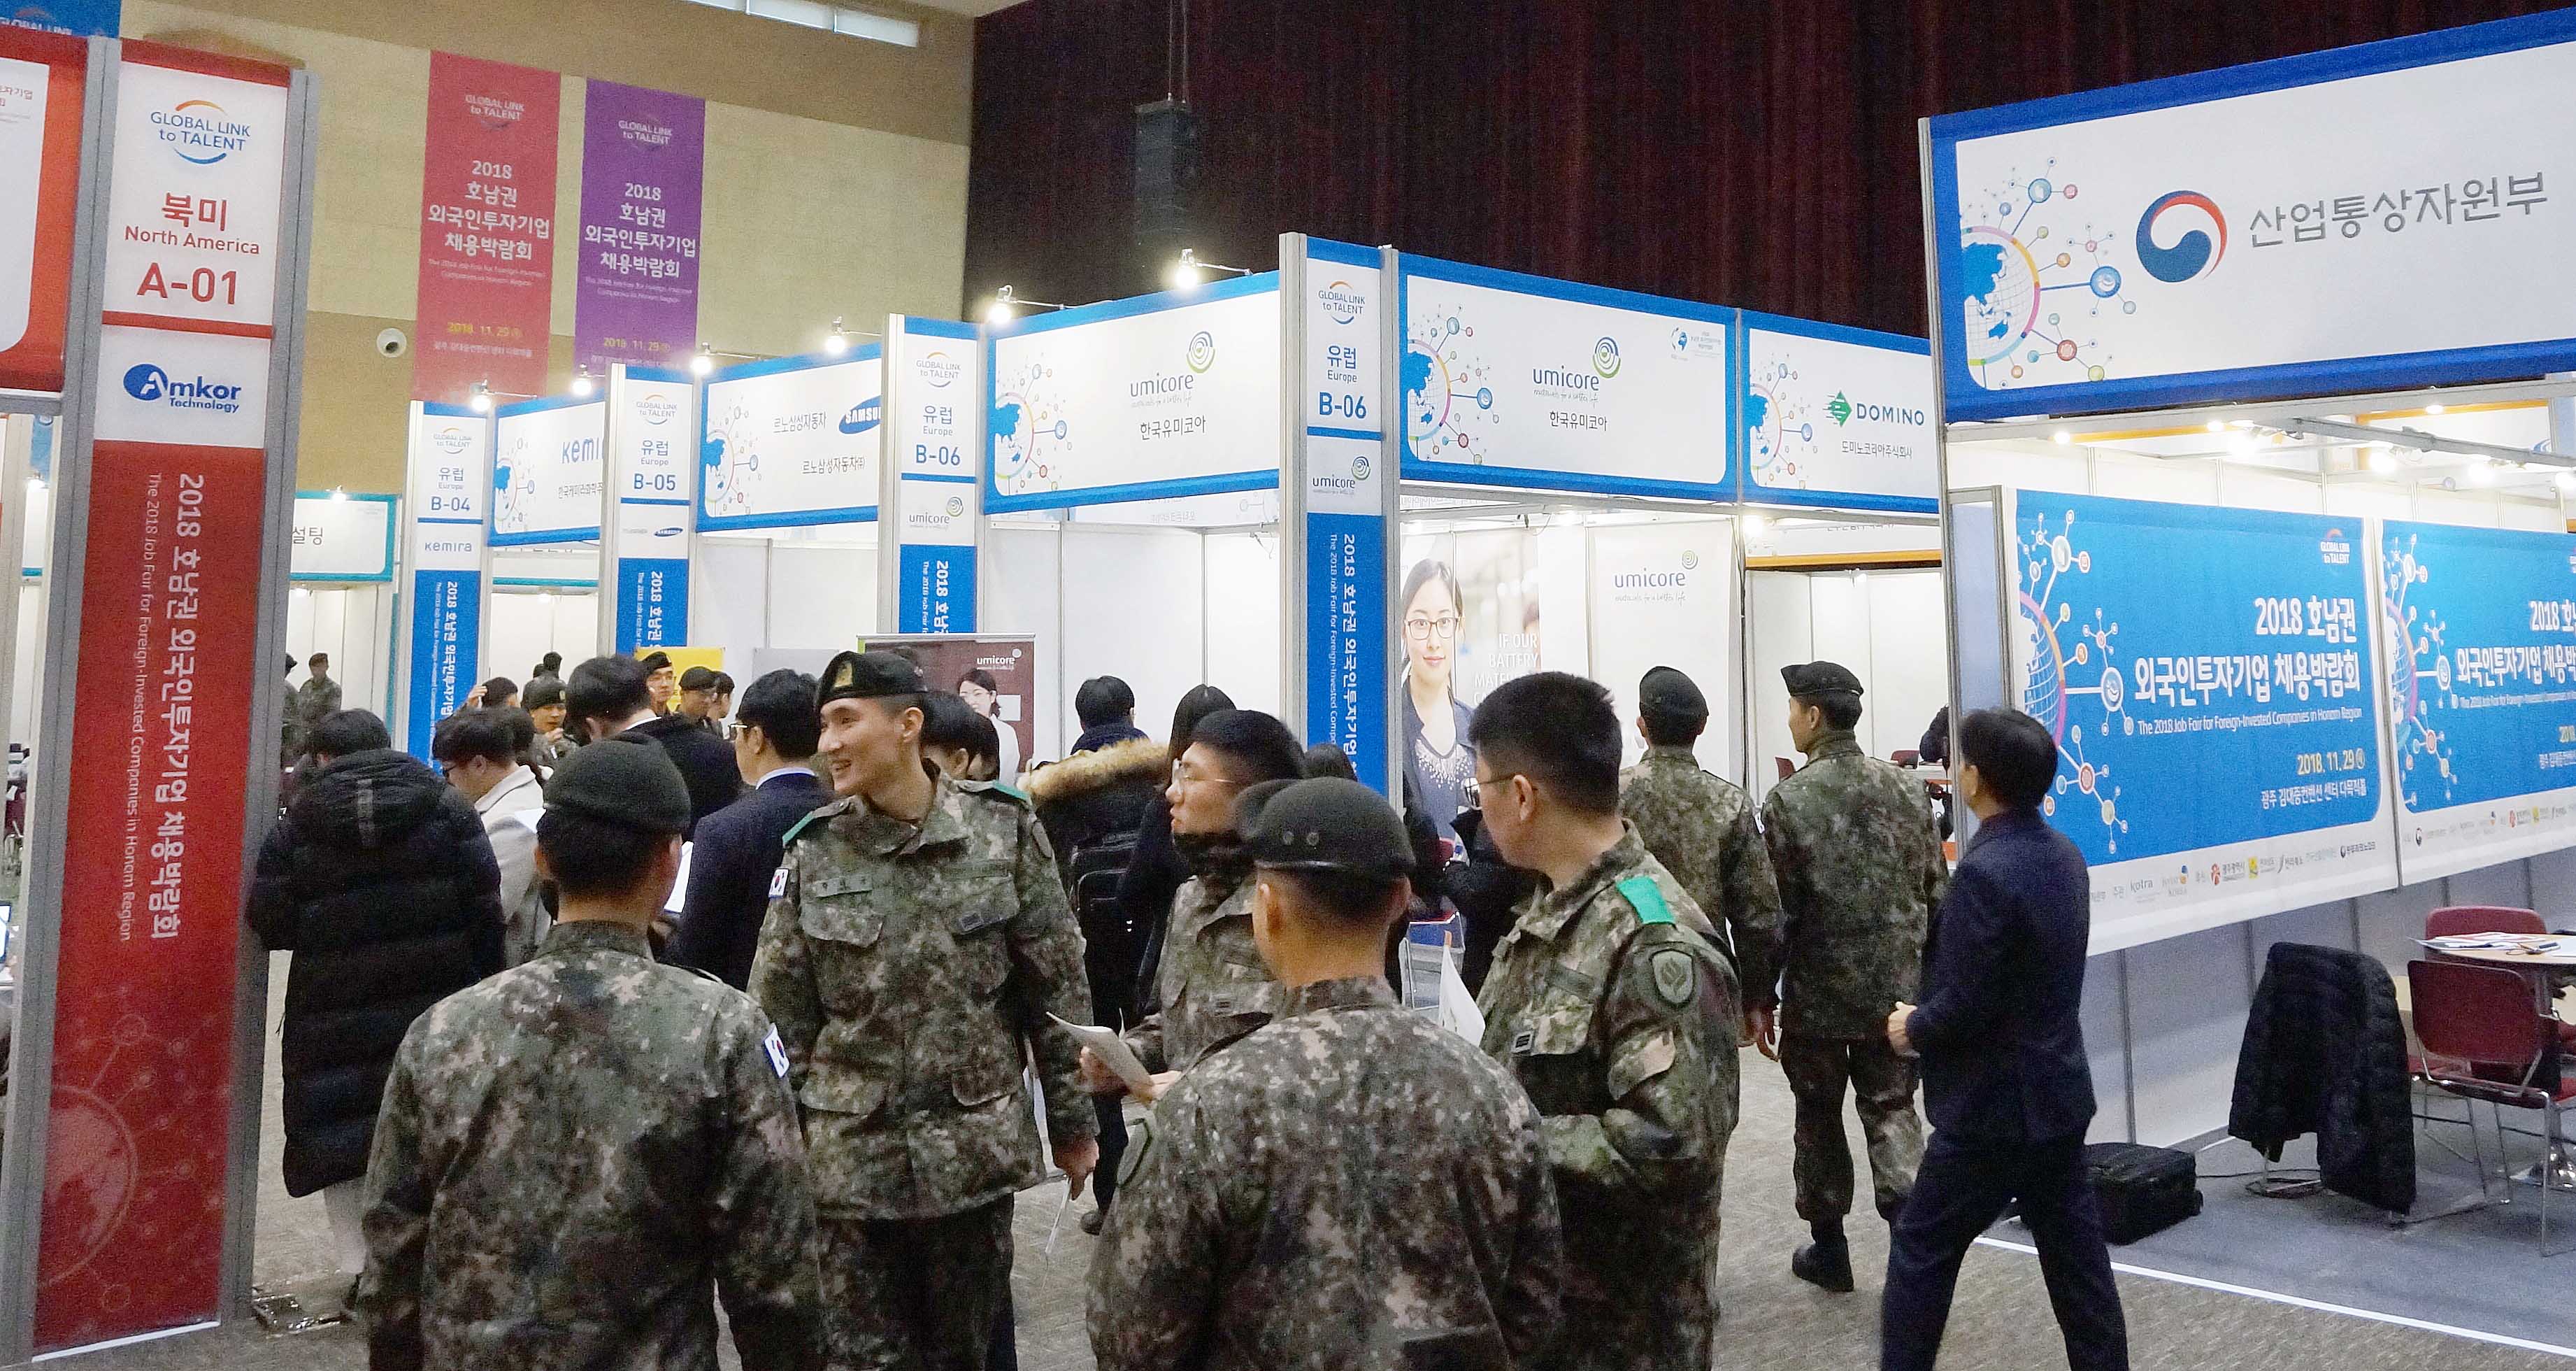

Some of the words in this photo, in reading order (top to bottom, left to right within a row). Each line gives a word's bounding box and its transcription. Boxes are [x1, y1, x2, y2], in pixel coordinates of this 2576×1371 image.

[465, 94, 502, 111] GLOBAL
[503, 99, 524, 113] LINK
[471, 106, 481, 115] to
[483, 108, 522, 122] TALENT
[150, 111, 213, 133] GLOBAL
[218, 121, 250, 138] LINK
[618, 120, 652, 135] GLOBAL
[653, 125, 672, 136] LINK
[159, 129, 176, 142] to
[181, 131, 246, 152] TALENT
[634, 132, 671, 145] TALENT
[472, 160, 512, 180] 2018
[464, 180, 517, 208] 호남권
[624, 183, 661, 201] 2018
[162, 192, 227, 231] 북미
[427, 204, 550, 240] 외국인투자기업
[620, 203, 666, 229] 호남권
[2249, 171, 2548, 248] 산업통상자원부
[125, 226, 178, 247] North
[183, 233, 259, 255] America
[444, 232, 532, 260] 채용박람회
[585, 225, 696, 257] 외국인투자기업
[600, 252, 680, 278] 채용박람회
[137, 262, 237, 305] A-01
[1318, 290, 1347, 303] GLOBAL
[1349, 294, 1366, 306] LINK
[1323, 302, 1331, 311] to
[1333, 302, 1364, 315] TALENT
[916, 360, 944, 369] GLOBAL
[945, 363, 961, 371] LINK
[1327, 346, 1357, 370] 유럽
[124, 363, 242, 402] Amkor
[930, 369, 959, 379] TALENT
[1130, 372, 1194, 397] umicore
[1327, 370, 1357, 384] Europe
[1533, 364, 1599, 391] umicore
[170, 397, 239, 413] Technology
[845, 406, 881, 425] SAMSU
[923, 405, 952, 425] 유럽
[1319, 392, 1367, 420] B-06
[1857, 403, 1924, 425] DOMINO
[773, 411, 827, 433] 르노삼성자동차
[923, 426, 953, 436] Europe
[1140, 415, 1206, 440] 한국유미코아
[1550, 411, 1608, 432] 한국유미코아
[561, 436, 604, 464] kemi
[641, 439, 668, 456] 유럽
[916, 444, 961, 466] B-06
[1841, 441, 1912, 459] 도미노코리아주식회사
[438, 467, 464, 481] 유럽
[641, 457, 668, 467] Europe
[148, 472, 162, 497] The
[634, 473, 676, 491] B-05
[1312, 474, 1356, 489] umicore
[176, 474, 204, 537] 2018
[431, 496, 471, 512] B-04
[145, 501, 160, 534] 2018
[909, 512, 950, 524] umicore
[292, 526, 323, 546] 설팅
[424, 542, 472, 552] kemira
[144, 538, 157, 560] Job
[1343, 534, 1356, 577] 2018
[141, 564, 155, 589] Fair
[166, 546, 201, 620] 호남권
[650, 571, 663, 602] 2018
[936, 560, 949, 597] 2018
[1615, 567, 1686, 588] umicore
[141, 593, 153, 613] for
[447, 581, 458, 608] 2018
[1343, 583, 1357, 632] 호남권
[2253, 597, 2303, 636] 2018
[2307, 595, 2357, 644] 호남권
[2528, 600, 2561, 631] 2018
[444, 611, 457, 641] 호남권
[647, 606, 663, 640] 호남권
[1498, 632, 1510, 648] IF
[1513, 632, 1538, 648] OUR
[976, 655, 1015, 665] umicore
[1489, 653, 1538, 668] BATTERY
[2456, 646, 2543, 688] 외국인투자기업
[2544, 644, 2576, 683] 채용박
[133, 617, 151, 732] Foreign-Invested
[441, 645, 456, 716] 외국인투자기업
[2134, 654, 2270, 708] 외국인투자기업
[2275, 649, 2361, 702] 채용박람회
[1343, 638, 1358, 755] 외국인투자기업
[155, 627, 196, 803] 외국인투자기업
[2138, 720, 2153, 735] The
[2154, 718, 2173, 734] 2018
[2173, 716, 2187, 732] Job
[2189, 716, 2203, 731] Fair
[2203, 716, 2214, 730] for
[2273, 710, 2310, 727] Companies
[2298, 753, 2326, 776] 2018.
[2326, 751, 2342, 772] 11.
[127, 737, 144, 816] Companies
[2261, 790, 2277, 810] 광주
[127, 819, 141, 831] in
[123, 836, 138, 886] Honam
[148, 811, 185, 939] 채용박람회
[118, 892, 135, 941] Region
